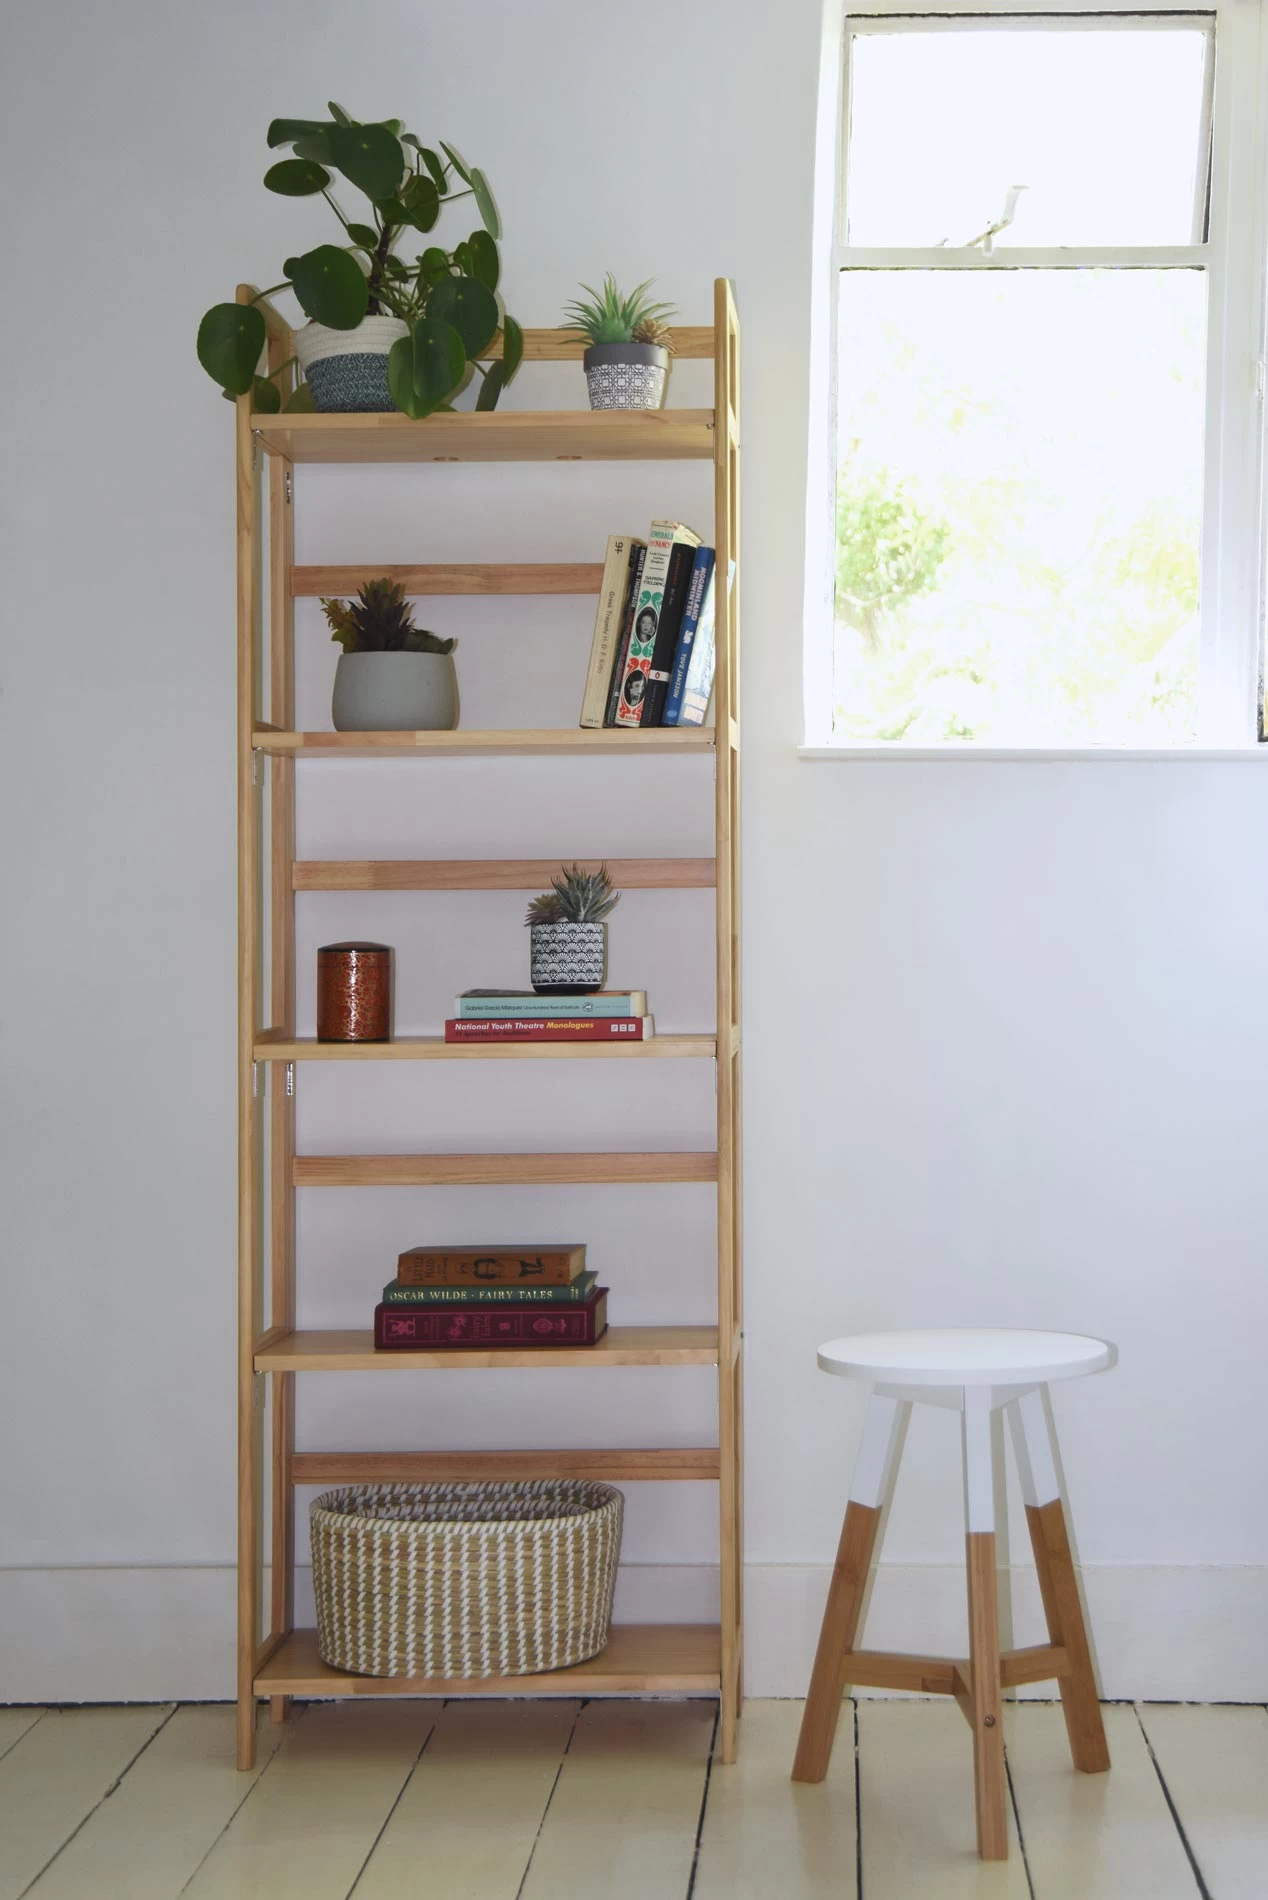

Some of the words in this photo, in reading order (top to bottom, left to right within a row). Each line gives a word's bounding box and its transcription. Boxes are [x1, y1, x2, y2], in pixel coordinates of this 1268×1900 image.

[685, 569, 700, 617] MIDWINTER
[691, 566, 707, 621] MOOMINLAND
[680, 653, 688, 670] TOVE
[455, 1022, 490, 1031] National
[491, 1021, 513, 1030] Youth
[515, 1021, 545, 1030] Theatre
[546, 1021, 594, 1030] Monologues
[390, 1291, 425, 1300] OSCAR
[429, 1291, 467, 1300] WILDE
[479, 1290, 513, 1299] FAIRY
[517, 1290, 553, 1299] TALES
